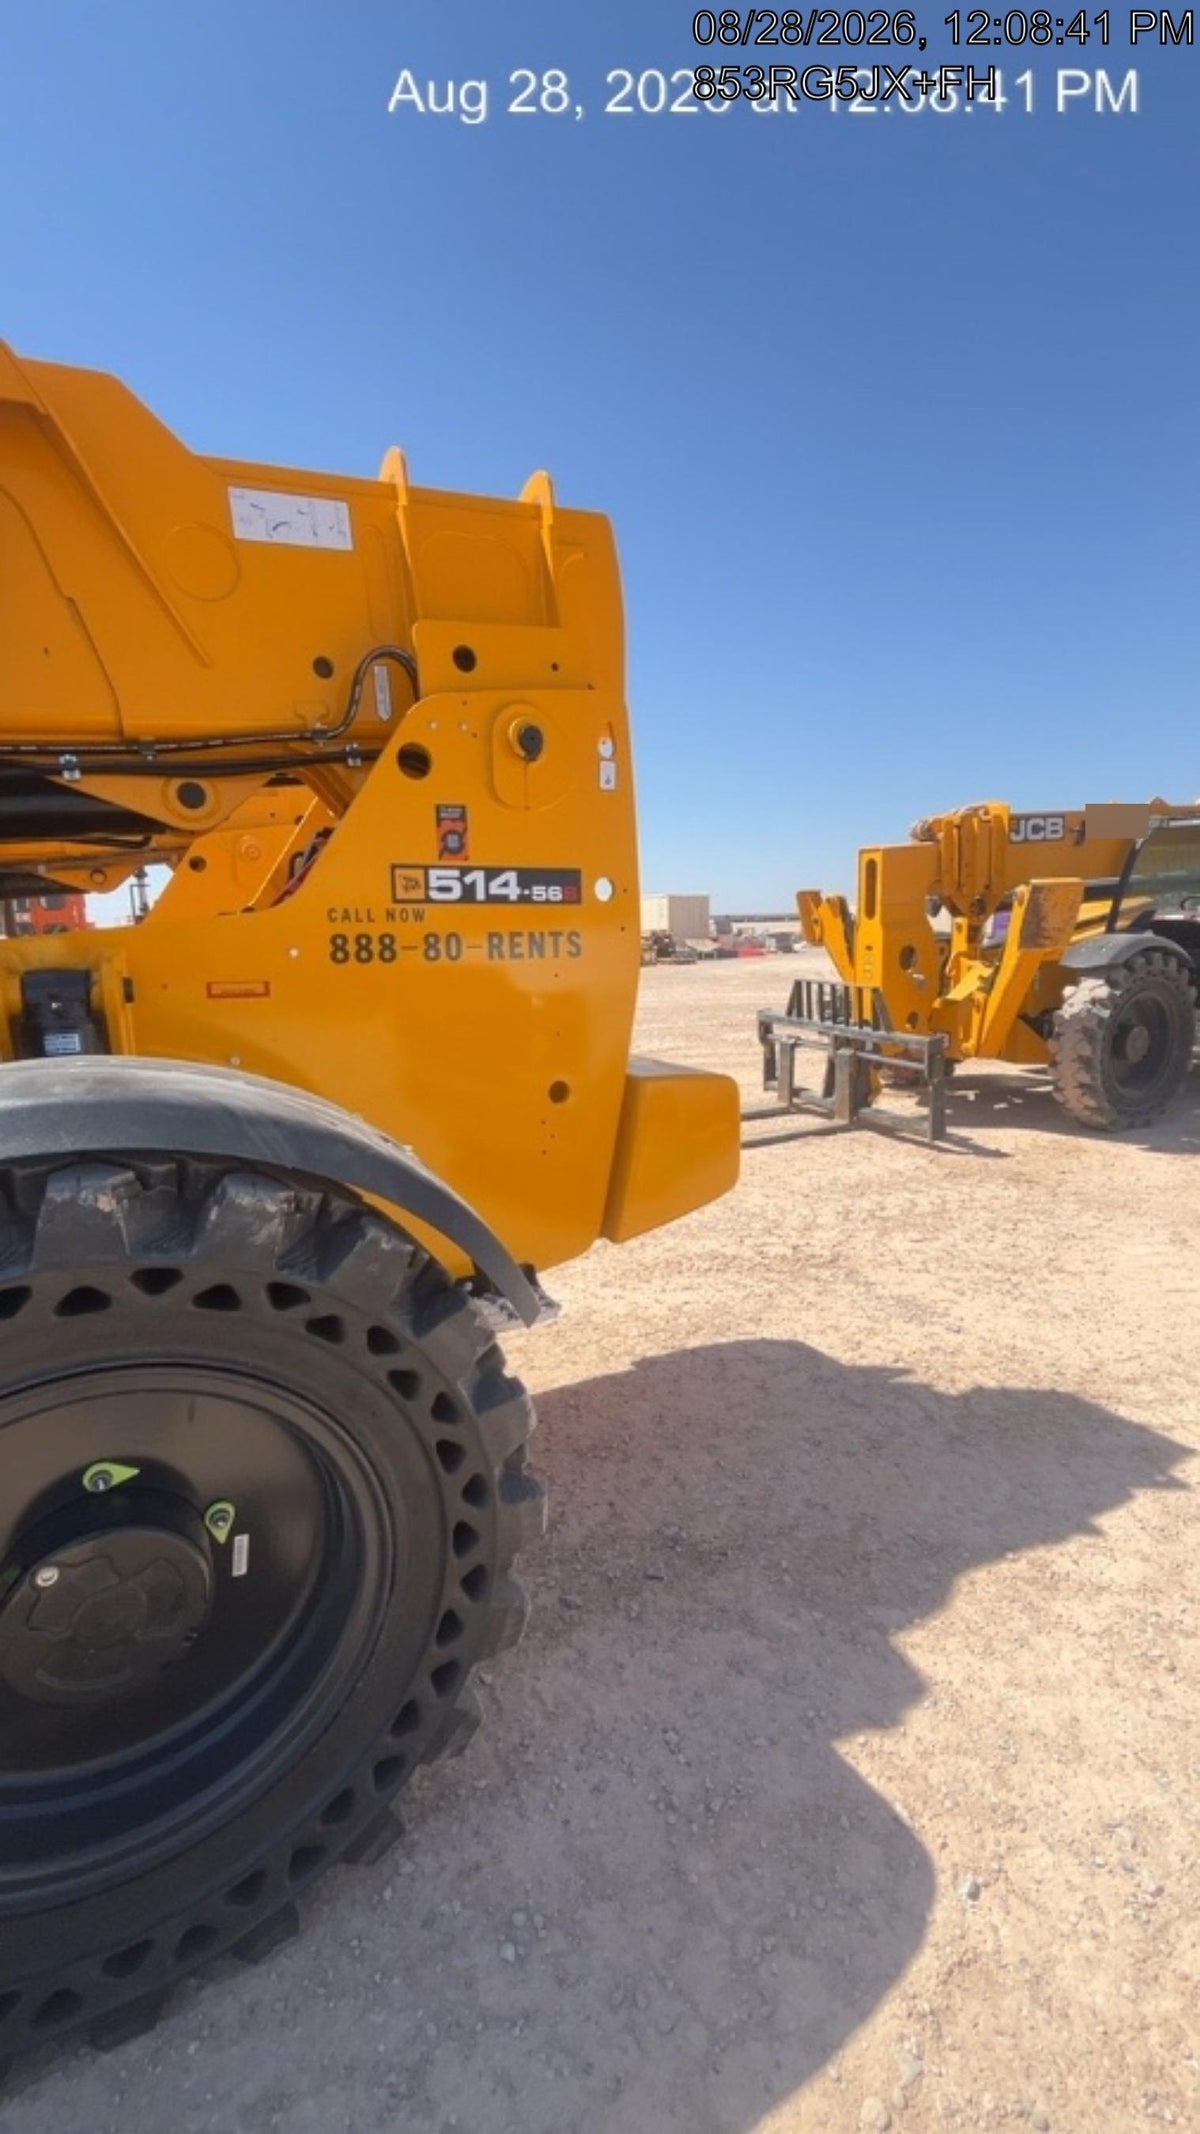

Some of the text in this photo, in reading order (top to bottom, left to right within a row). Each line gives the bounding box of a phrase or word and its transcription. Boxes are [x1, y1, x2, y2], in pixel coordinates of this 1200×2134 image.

[1010, 816, 1065, 843] JCB
[327, 908, 426, 924] CALL NOW
[329, 931, 582, 964] 888-80-RENTS
